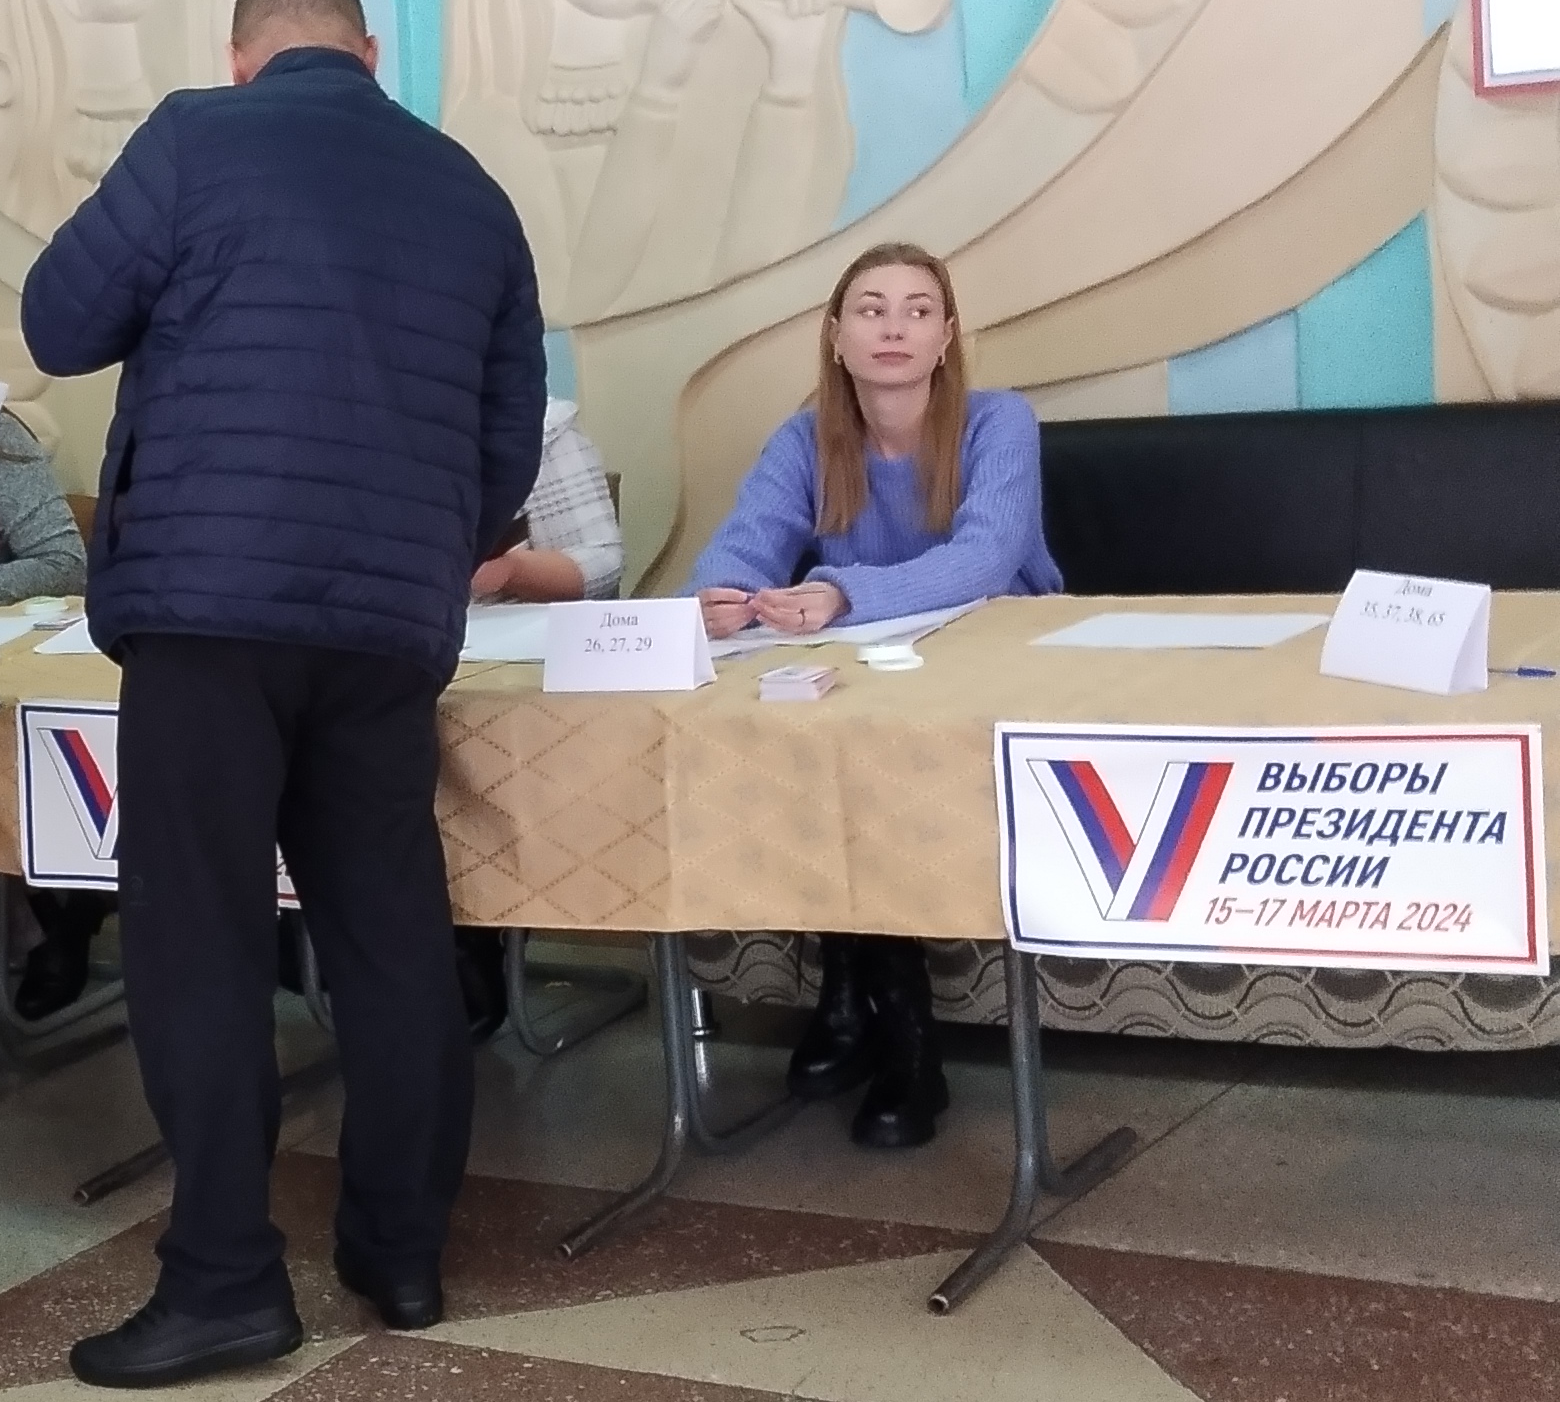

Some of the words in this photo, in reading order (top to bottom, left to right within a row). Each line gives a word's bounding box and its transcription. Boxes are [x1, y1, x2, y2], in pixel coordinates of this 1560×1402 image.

[1393, 579, 1433, 598] Дома
[599, 612, 639, 629] Дома
[584, 638, 605, 653] 26,
[609, 637, 630, 653] 27,
[634, 637, 653, 652] 29
[1256, 761, 1449, 795] ВЫБОРЫ
[1237, 806, 1508, 847] ПРЕЗИДЕНТА
[1218, 852, 1391, 889] РОССИИ
[1287, 899, 1392, 931] МАРТА
[1396, 902, 1474, 934] 2024
